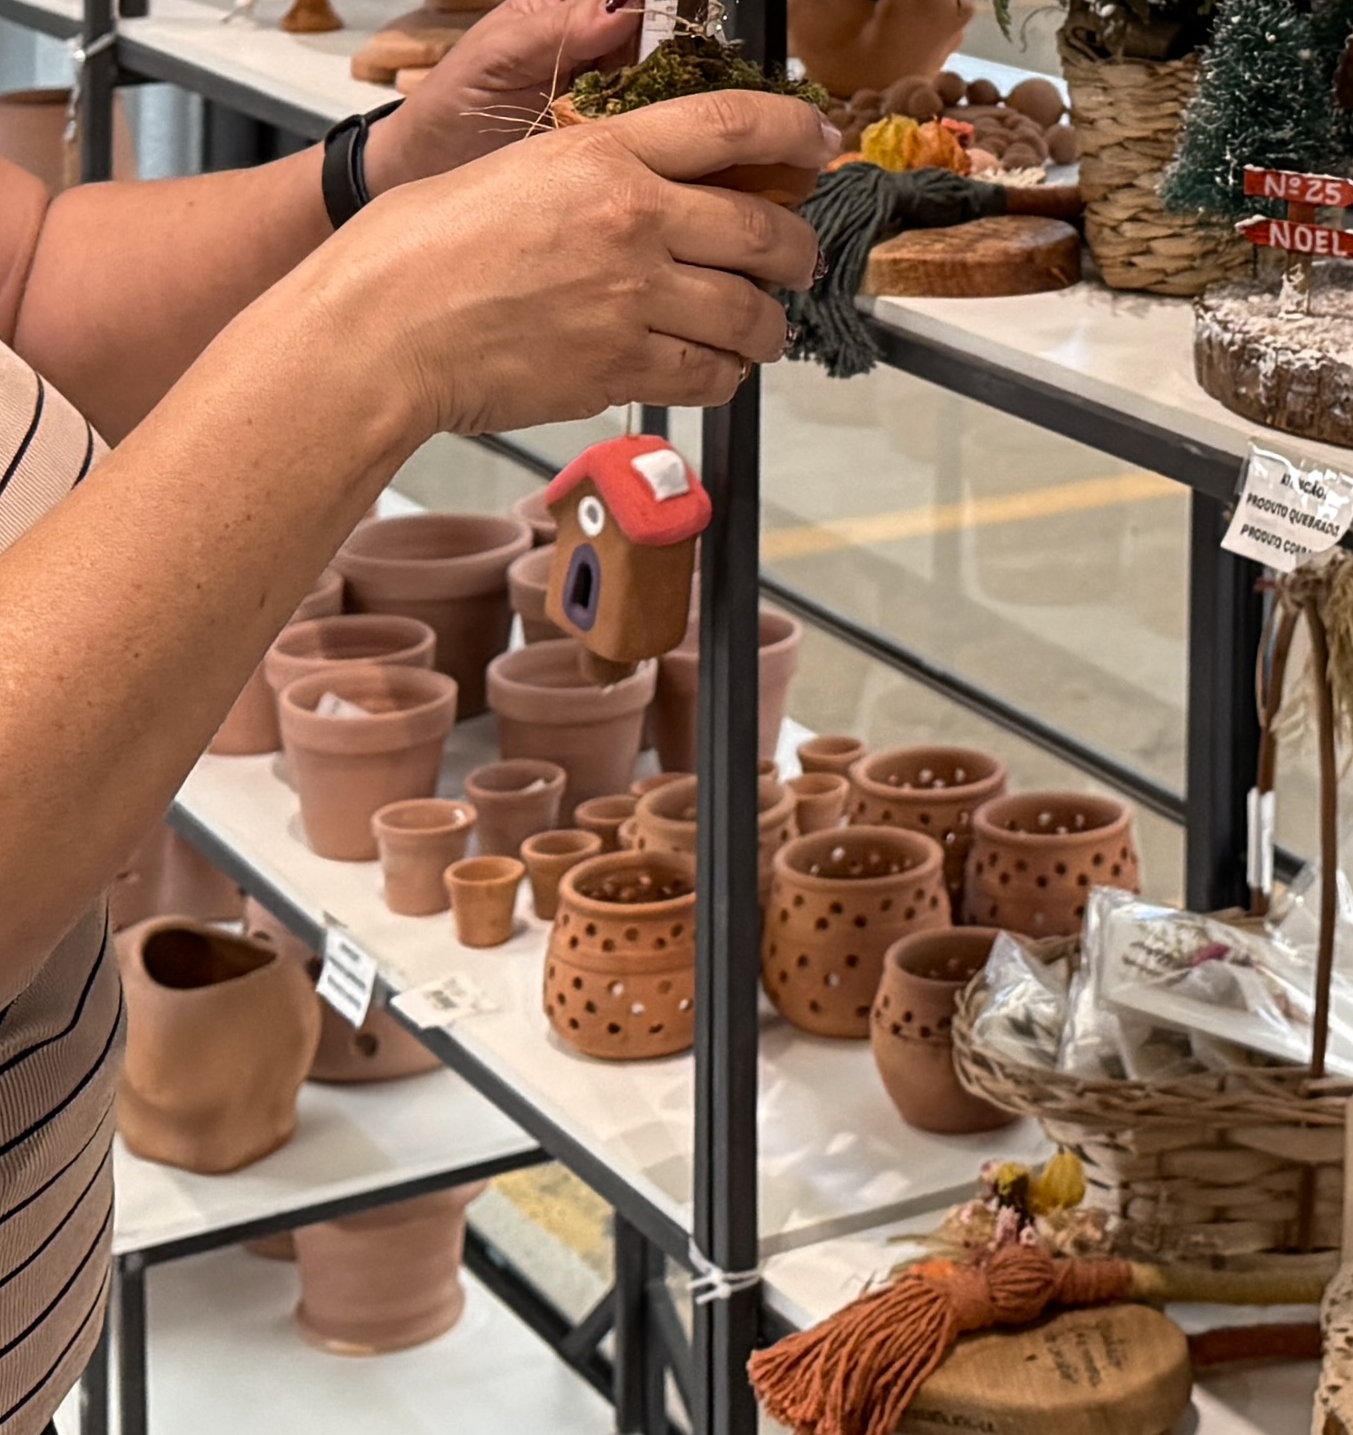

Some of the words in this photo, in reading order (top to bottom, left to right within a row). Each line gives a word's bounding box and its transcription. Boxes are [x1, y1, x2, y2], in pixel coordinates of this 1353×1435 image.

[1304, 179, 1342, 205] 25
[1269, 220, 1347, 256] NOEL
[1247, 492, 1289, 518] PRODUTO
[1240, 523, 1282, 549] PRODUTO
